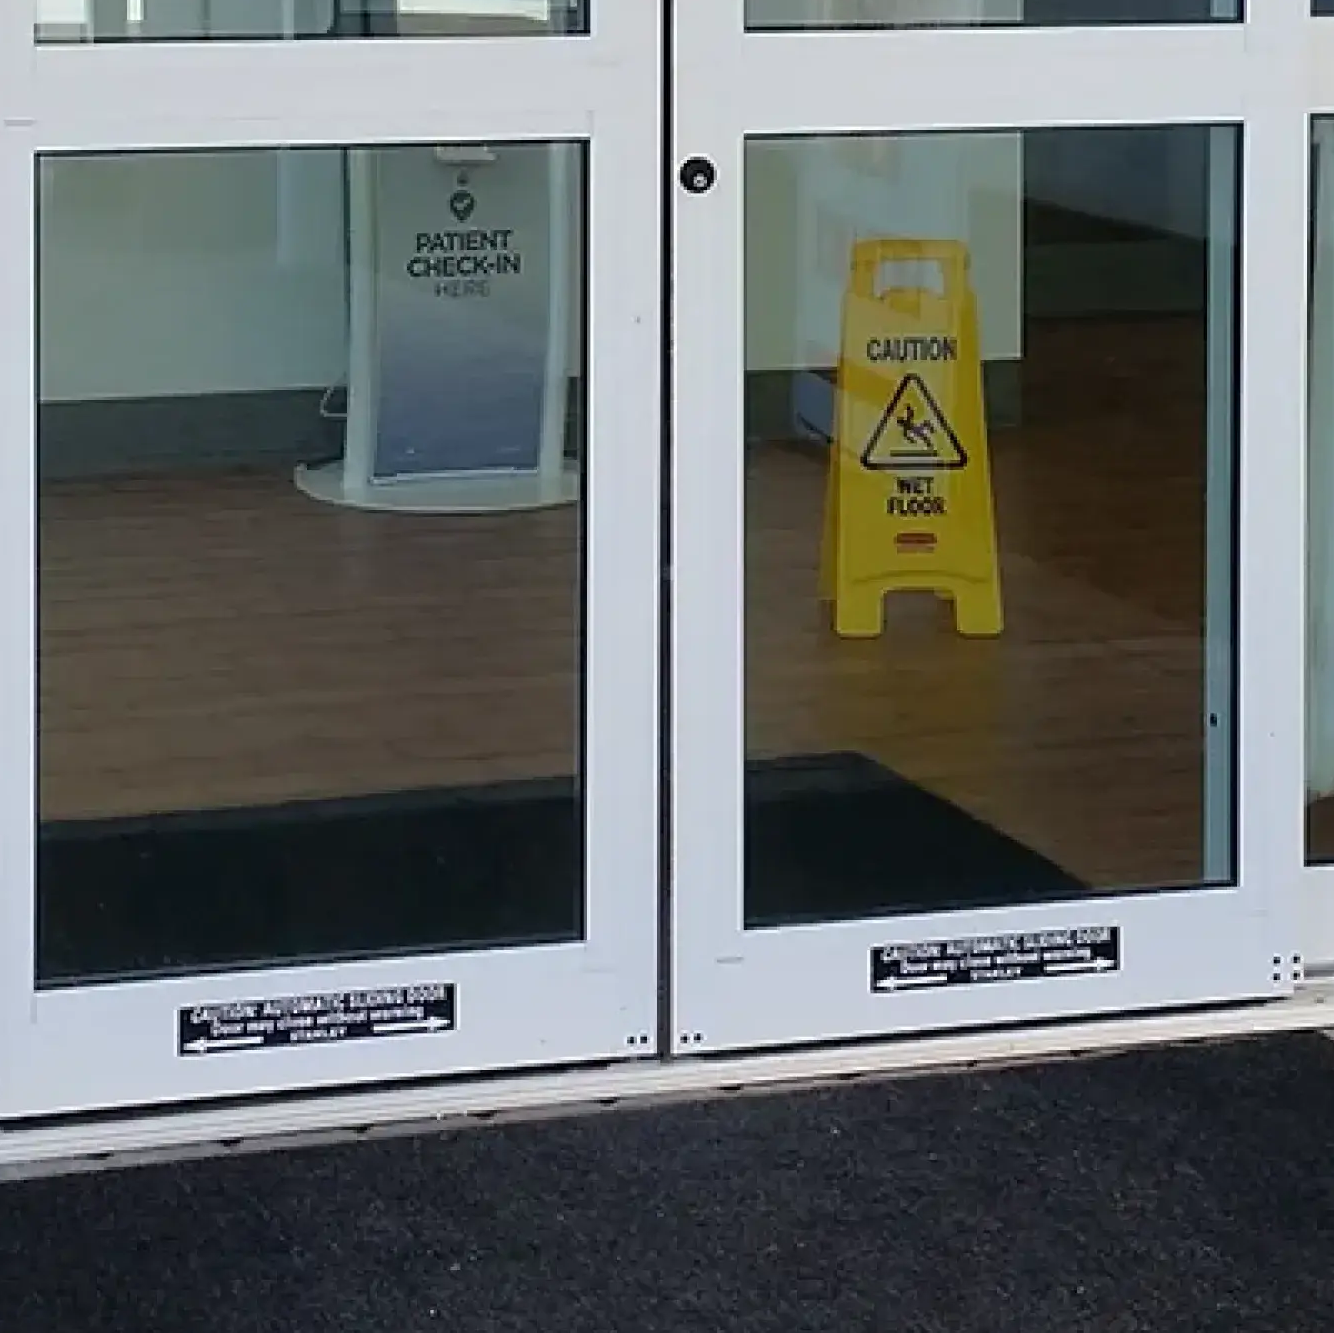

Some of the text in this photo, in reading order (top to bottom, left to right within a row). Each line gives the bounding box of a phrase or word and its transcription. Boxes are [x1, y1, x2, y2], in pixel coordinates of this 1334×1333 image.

[416, 230, 513, 253] PATIENT
[406, 253, 521, 278] CHECK-IN
[866, 336, 958, 362] CAUTION
[896, 476, 934, 494] WET
[886, 496, 947, 517] FLOOR
[946, 936, 1021, 957] AUTOMATIC
[1023, 931, 1073, 949] SLIDING
[1076, 927, 1111, 944] DOOR
[262, 993, 345, 1017] AUTOMATIC
[349, 989, 405, 1009] SLIDING
[407, 985, 446, 1002] DOOR
[210, 1005, 425, 1037] Door may close without warning
[289, 1026, 346, 1042] STANLEY
